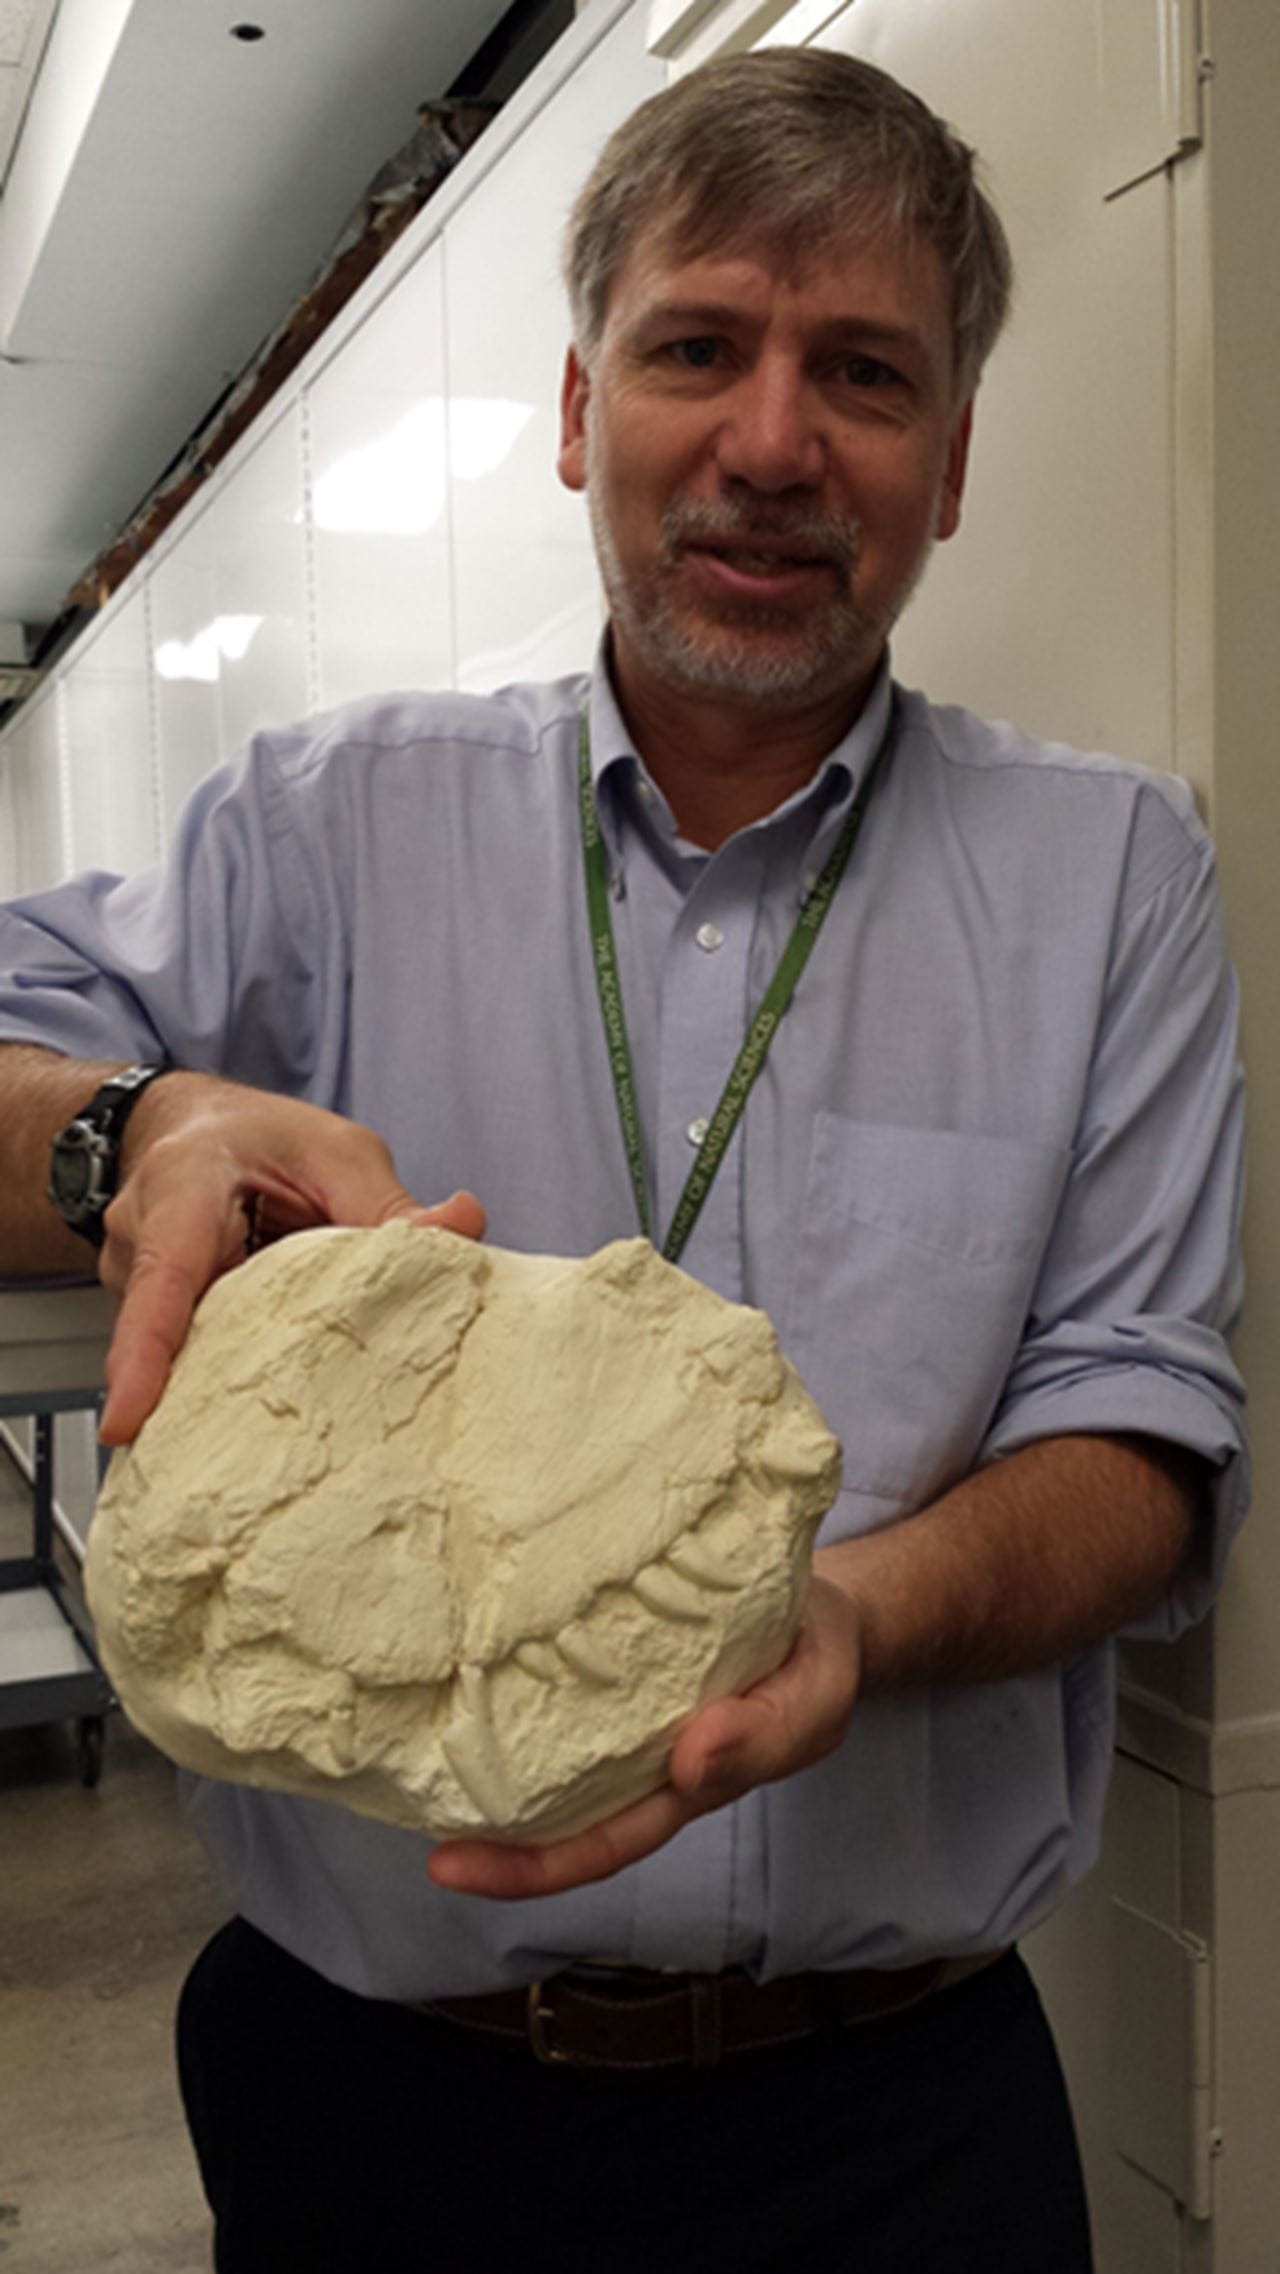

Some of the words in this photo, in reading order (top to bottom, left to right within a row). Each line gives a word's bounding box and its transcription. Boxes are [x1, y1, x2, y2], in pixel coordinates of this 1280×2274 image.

[596, 933, 613, 963] THE
[686, 1174, 707, 1201] OF
[698, 1095, 743, 1173] NATURAL
[730, 1010, 777, 1093] SCIENCES
